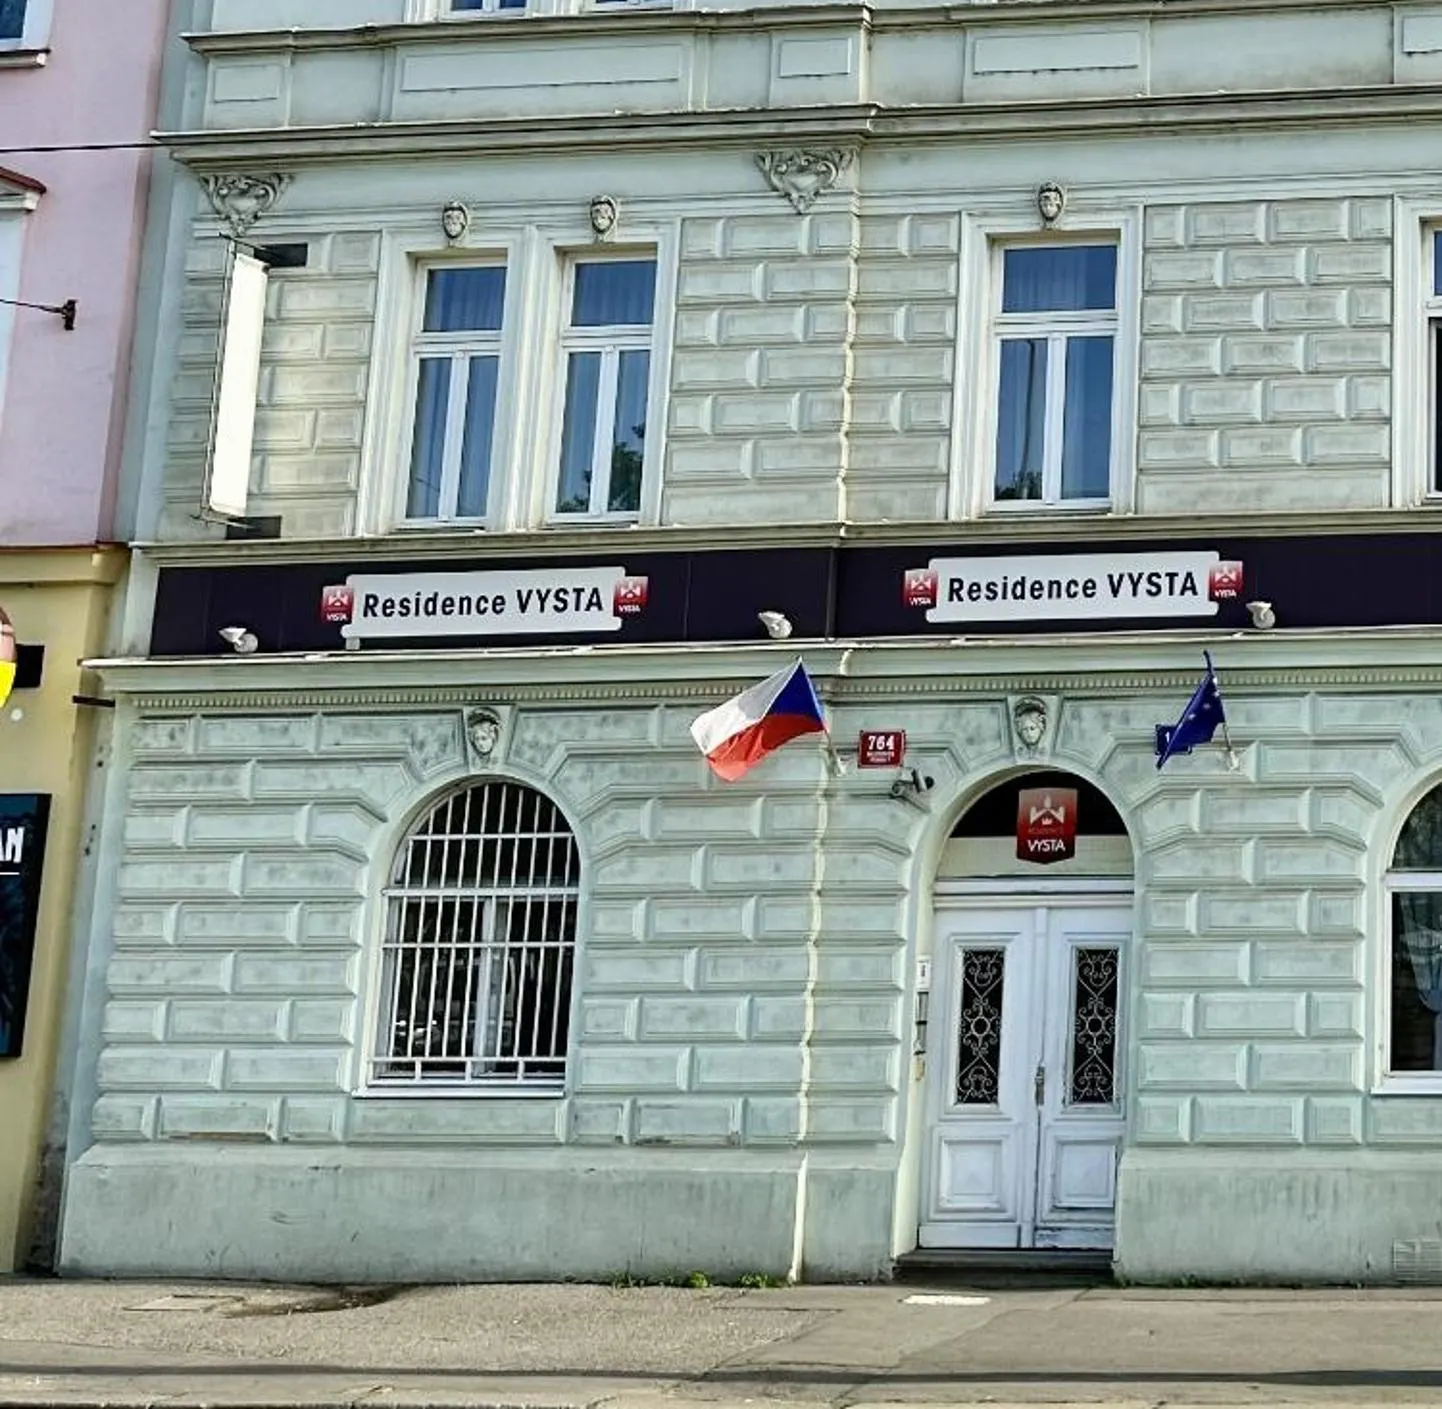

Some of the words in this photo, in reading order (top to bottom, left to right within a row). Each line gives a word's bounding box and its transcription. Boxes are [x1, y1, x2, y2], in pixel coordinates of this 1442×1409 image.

[947, 576, 1098, 603] Residence
[1107, 571, 1199, 598] VYSTA
[362, 591, 507, 618] Residence
[516, 587, 604, 613] VYSTA
[868, 735, 895, 750] 764
[1027, 839, 1066, 852] VYSTA
